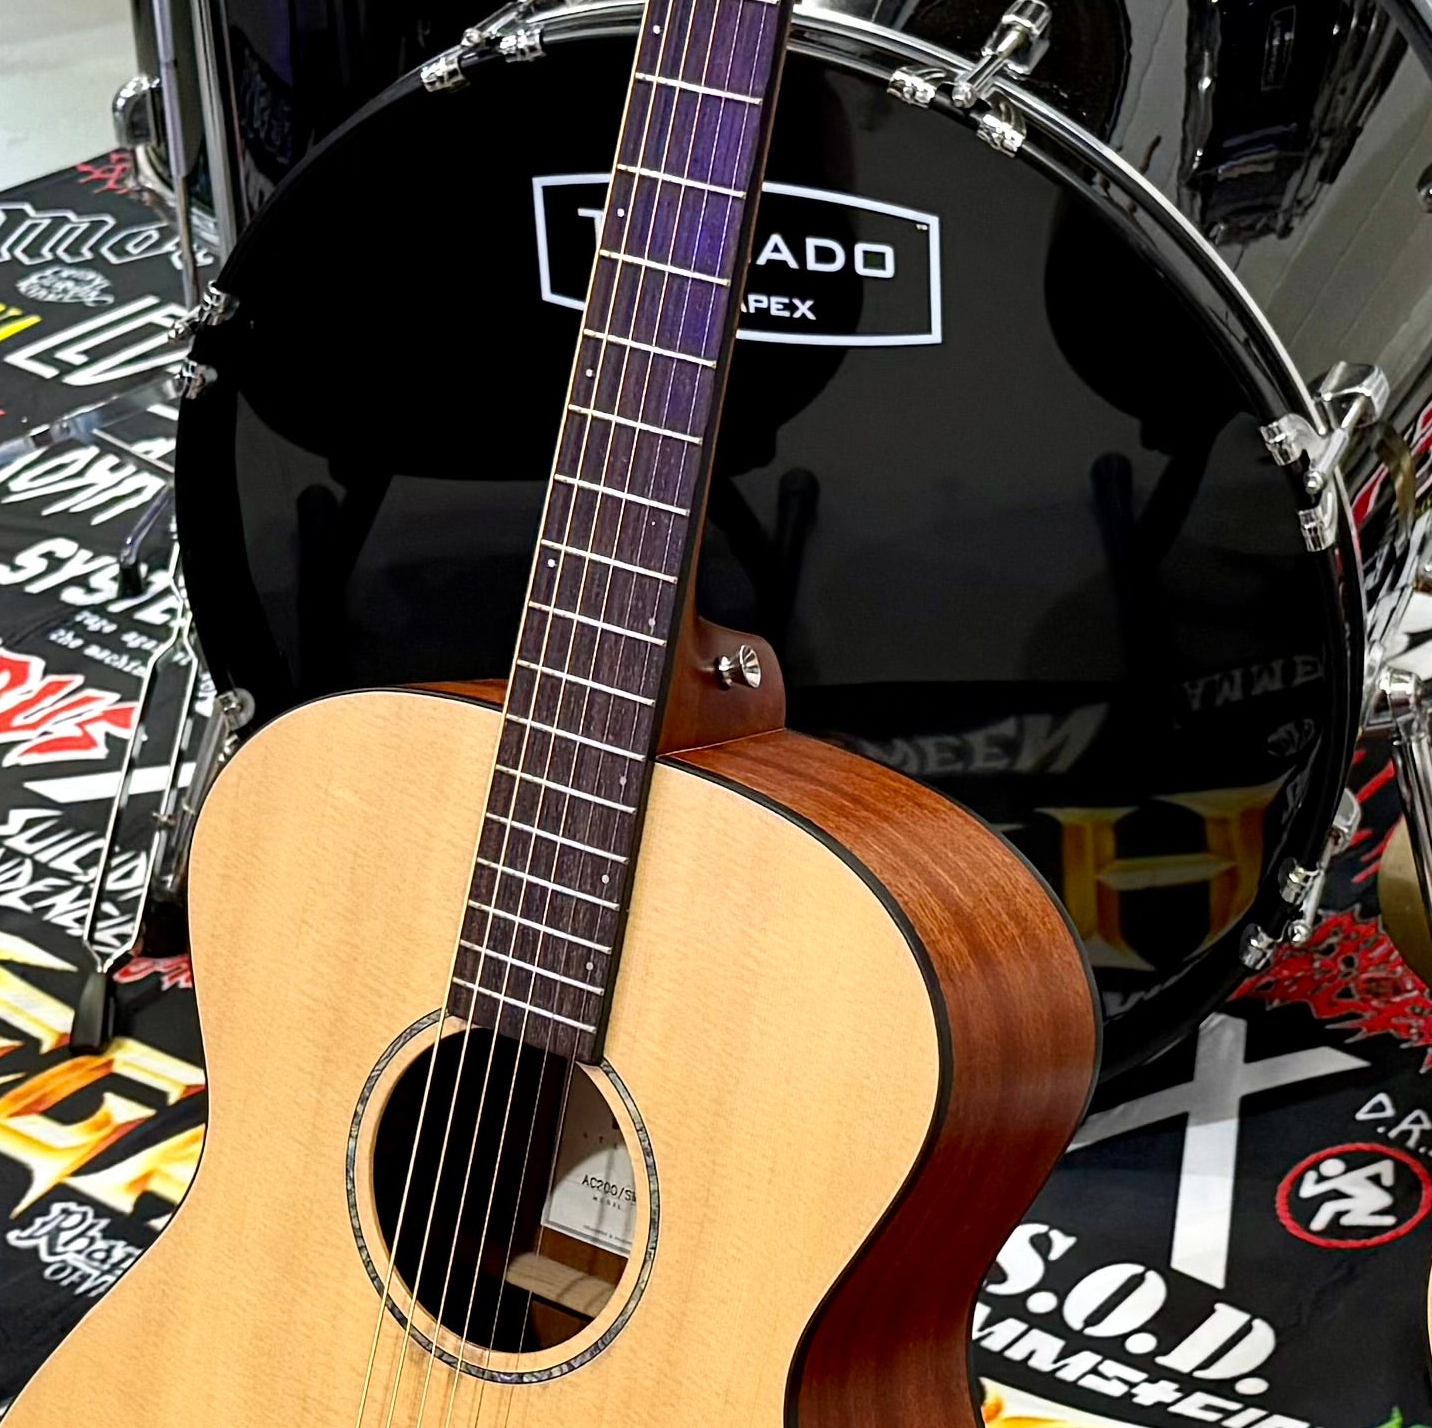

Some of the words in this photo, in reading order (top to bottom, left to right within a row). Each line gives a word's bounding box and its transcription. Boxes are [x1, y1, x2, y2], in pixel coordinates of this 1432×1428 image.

[577, 207, 896, 279] TADO
[741, 292, 818, 321] PEX
[975, 1222, 1277, 1396] S.O.D.
